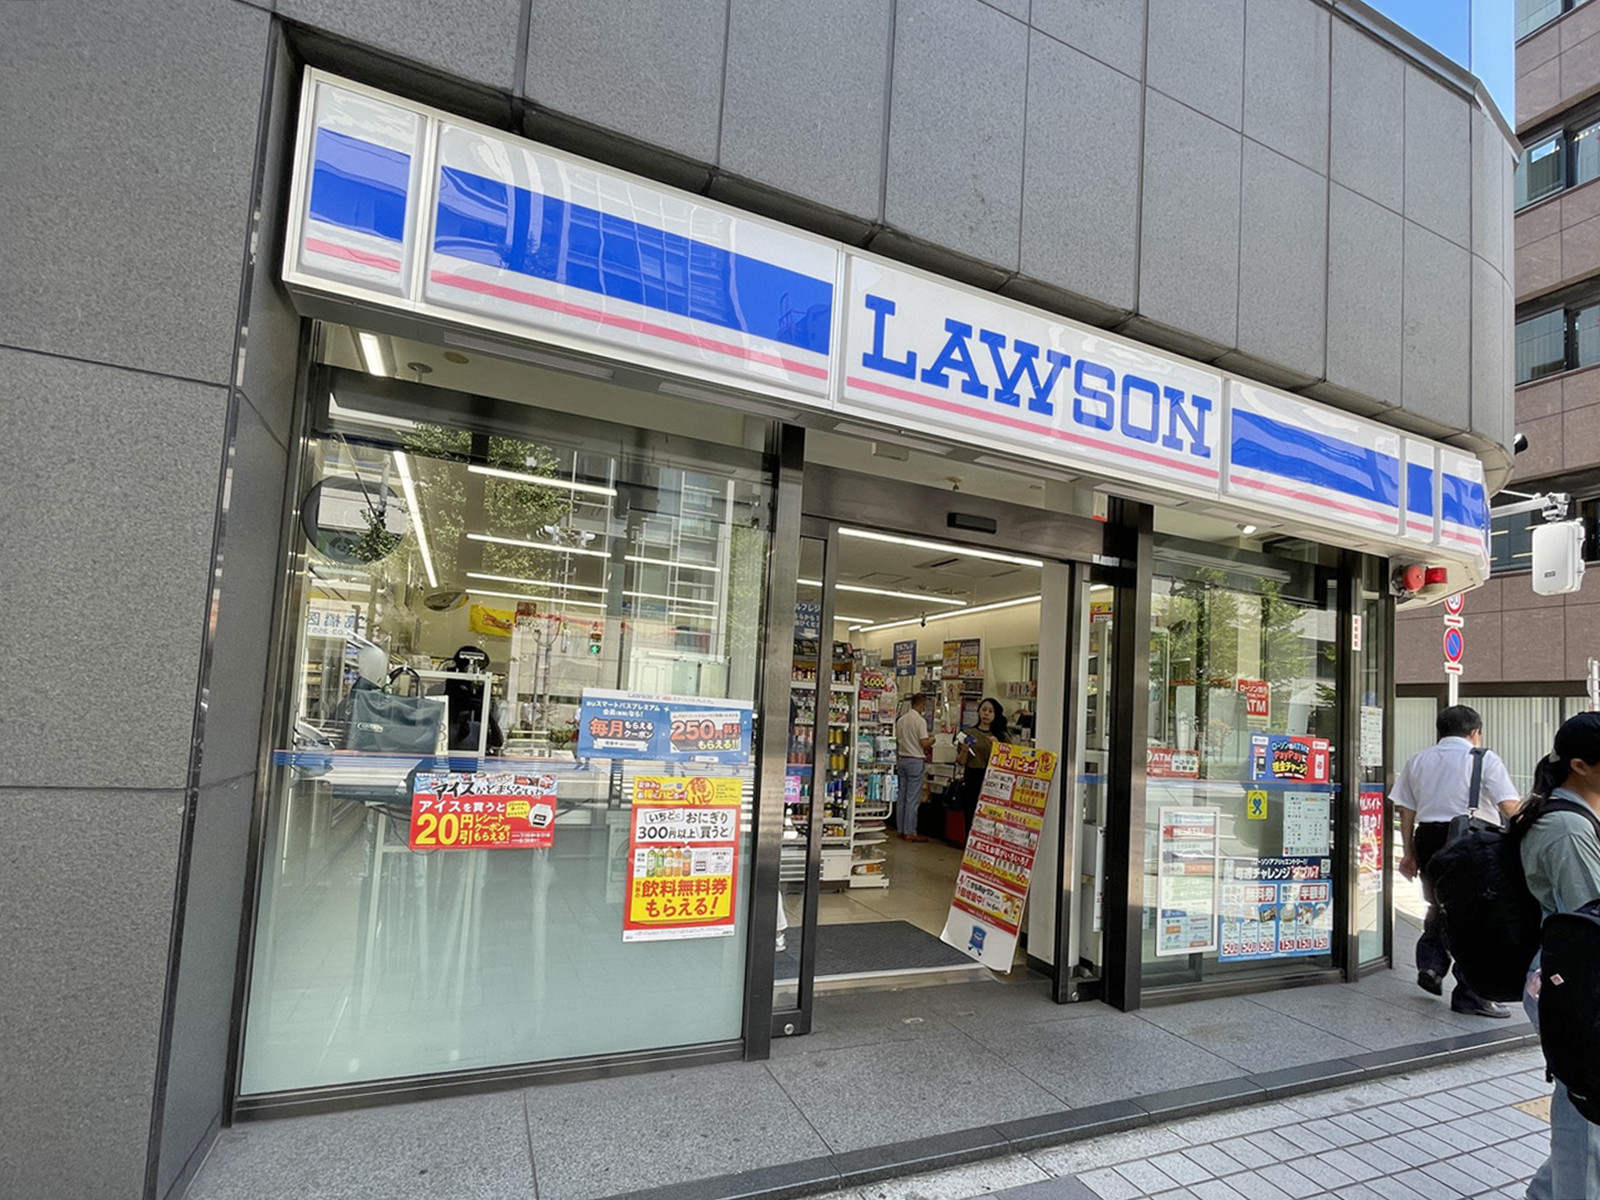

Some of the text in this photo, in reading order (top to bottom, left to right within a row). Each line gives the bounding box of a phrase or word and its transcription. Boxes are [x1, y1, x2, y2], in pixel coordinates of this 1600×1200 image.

[862, 294, 1212, 458] LAWSON
[590, 717, 624, 737] 毎月
[624, 731, 654, 739] クーポン
[418, 800, 506, 813] アイスを買うと
[475, 814, 505, 822] レシート
[685, 811, 728, 824] おにぎり
[474, 832, 510, 842] もらえる!
[638, 825, 729, 839] 300円以上 買うと
[642, 878, 728, 897] 飲料無料券
[645, 896, 719, 917] もらえる!
